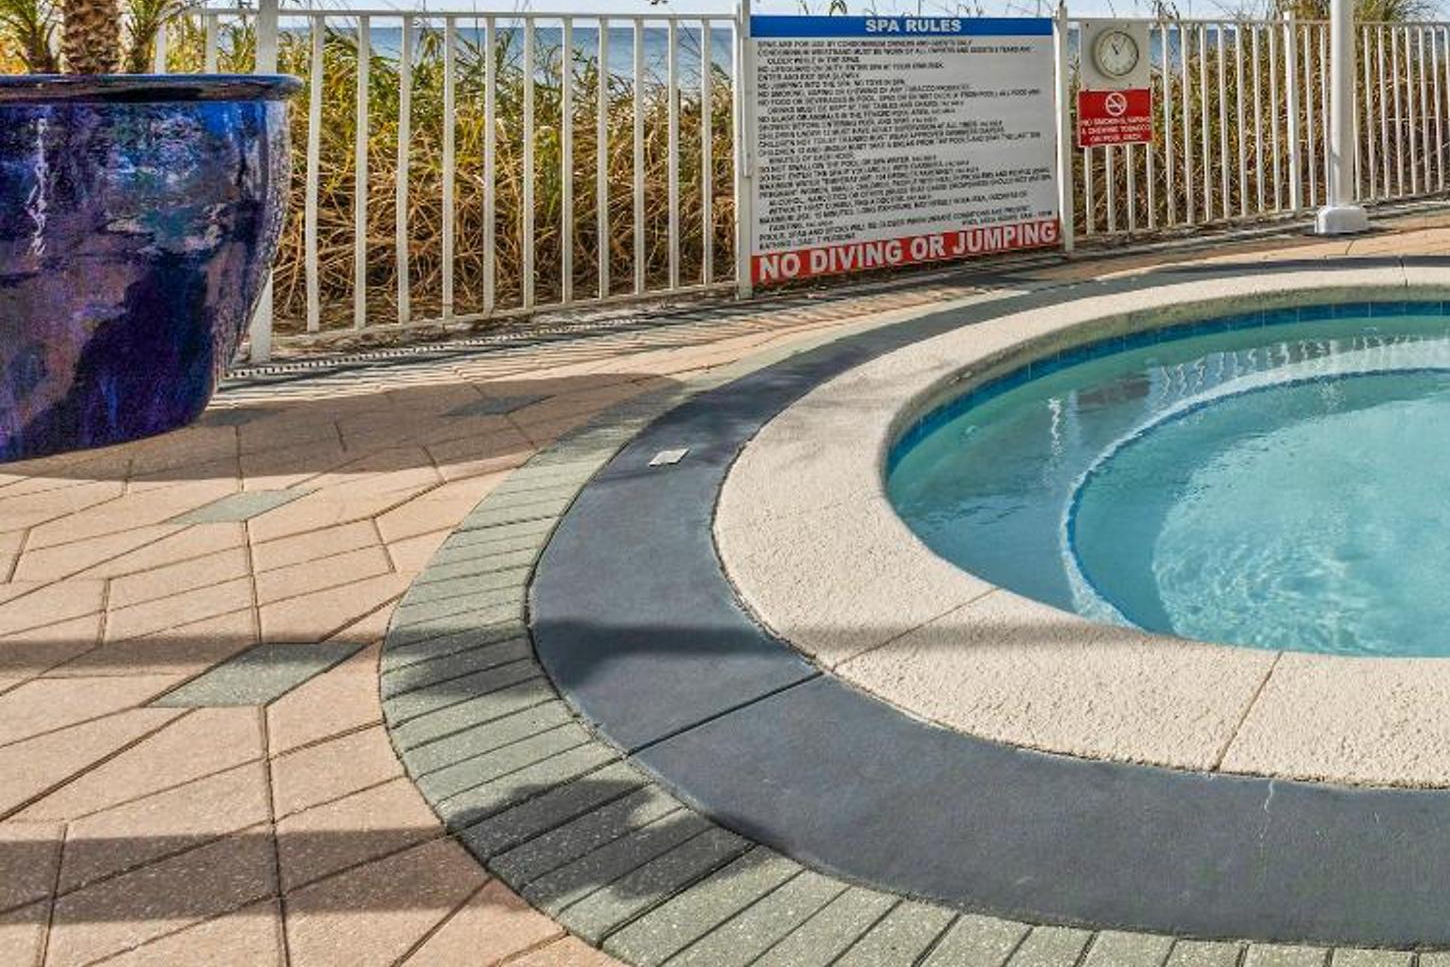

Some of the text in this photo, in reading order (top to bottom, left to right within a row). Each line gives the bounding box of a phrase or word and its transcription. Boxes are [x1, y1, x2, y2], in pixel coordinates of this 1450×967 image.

[865, 19, 962, 33] SPA RULES
[759, 252, 800, 283] NO
[810, 241, 902, 274] DIVING
[910, 235, 947, 261] OR
[952, 221, 1057, 255] JUMPING
